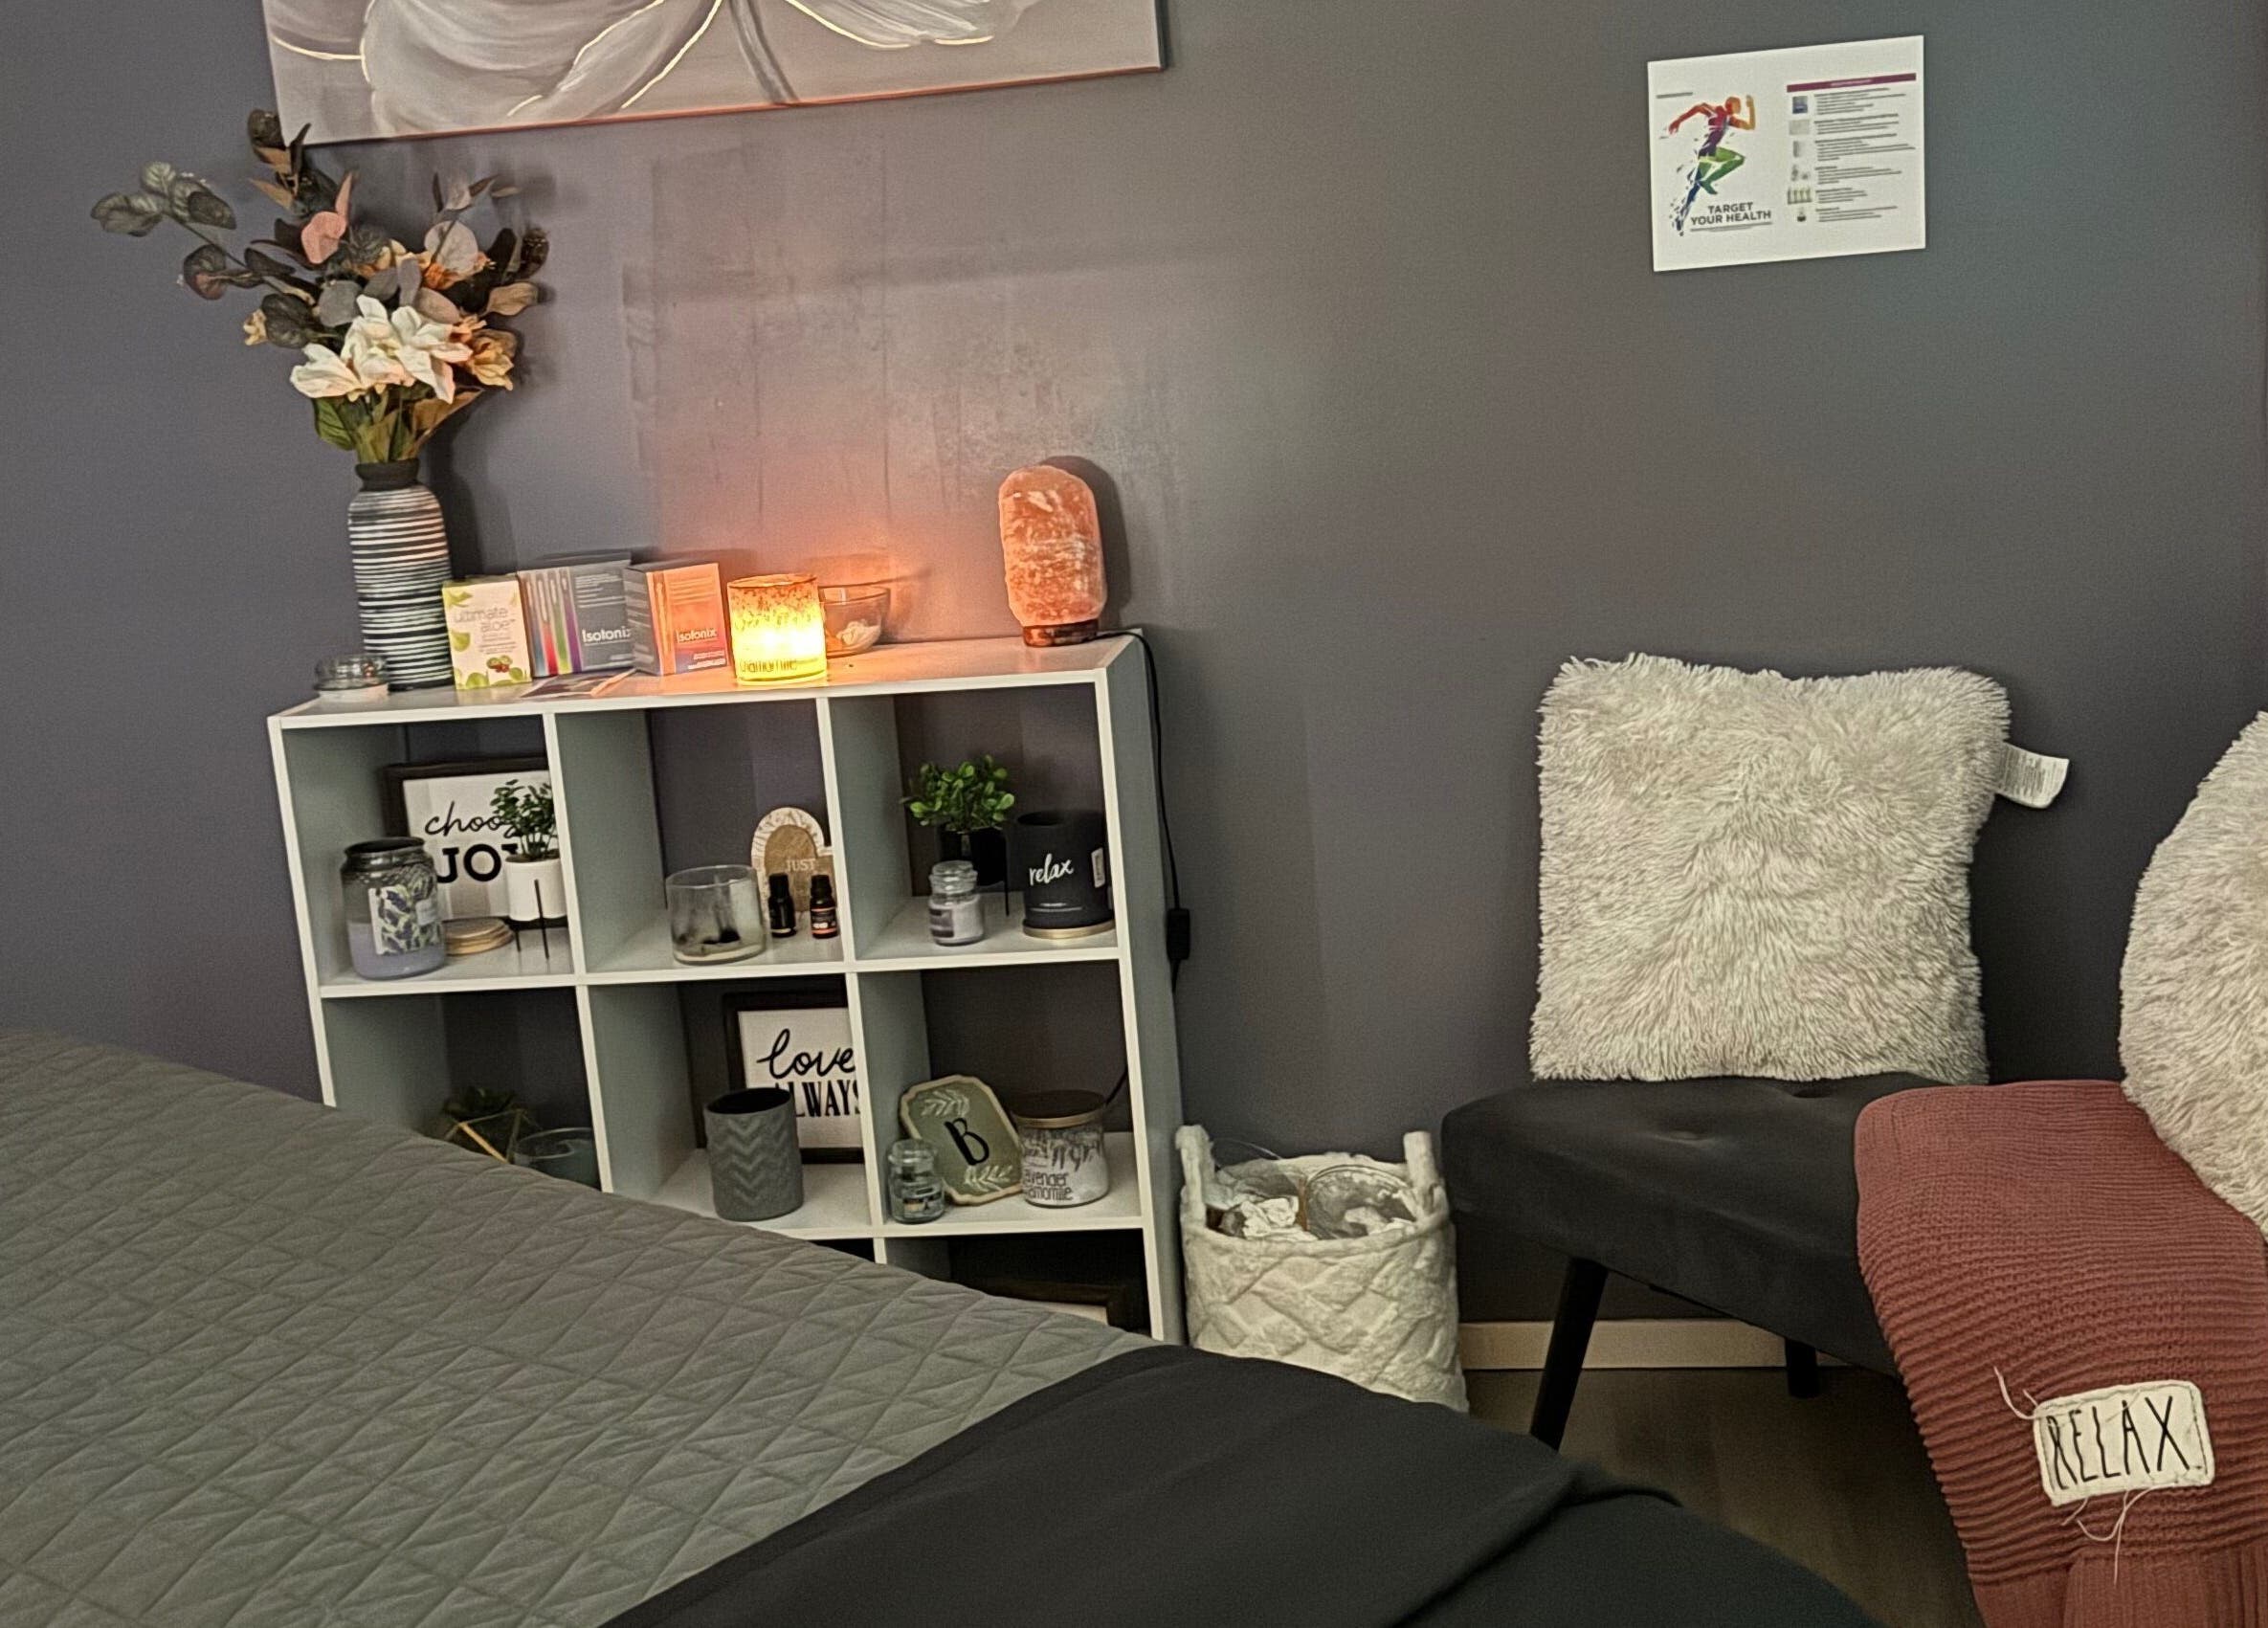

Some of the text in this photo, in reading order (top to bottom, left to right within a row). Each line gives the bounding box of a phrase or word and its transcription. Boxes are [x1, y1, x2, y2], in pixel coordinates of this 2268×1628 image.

[1691, 210, 1771, 225] YOUR HEALTH
[1708, 202, 1753, 213] TARGET
[424, 800, 558, 839] choo
[1029, 853, 1074, 886] relax
[756, 1028, 856, 1080] love
[944, 1117, 989, 1166] B
[2046, 1394, 2190, 1490] RELAX
